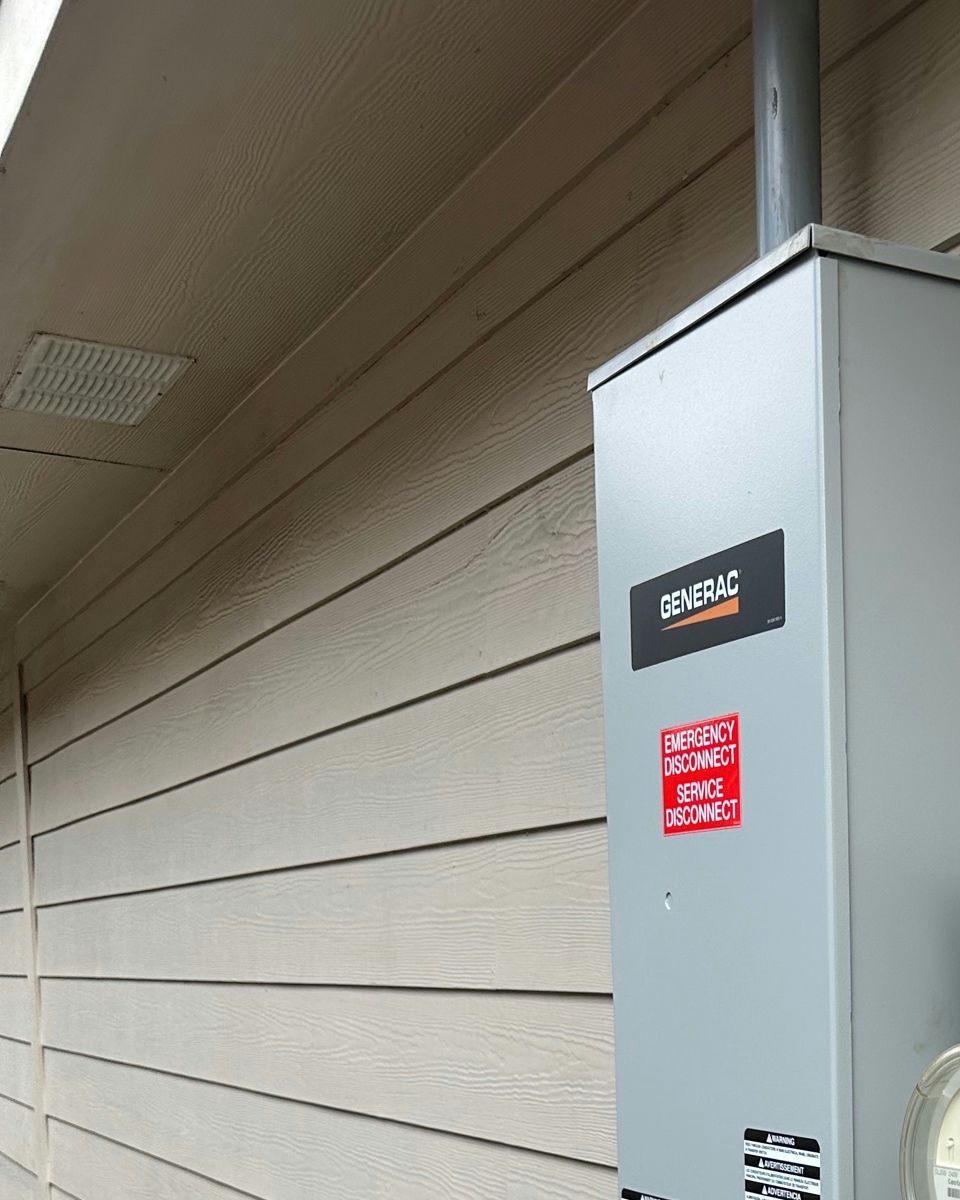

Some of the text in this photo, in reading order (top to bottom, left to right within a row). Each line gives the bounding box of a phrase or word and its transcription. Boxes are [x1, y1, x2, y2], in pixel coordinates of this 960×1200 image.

[660, 569, 739, 620] GENERAC
[664, 720, 735, 754] EMERGENCY
[664, 744, 737, 776] DISCONNECT
[676, 777, 724, 804] SERVICE
[665, 799, 738, 827] DISCONNECT
[771, 1134, 794, 1145] WARNING
[764, 1159, 804, 1175] AVERTISSEMENT
[767, 1186, 801, 1200] ADVERTENCIA
